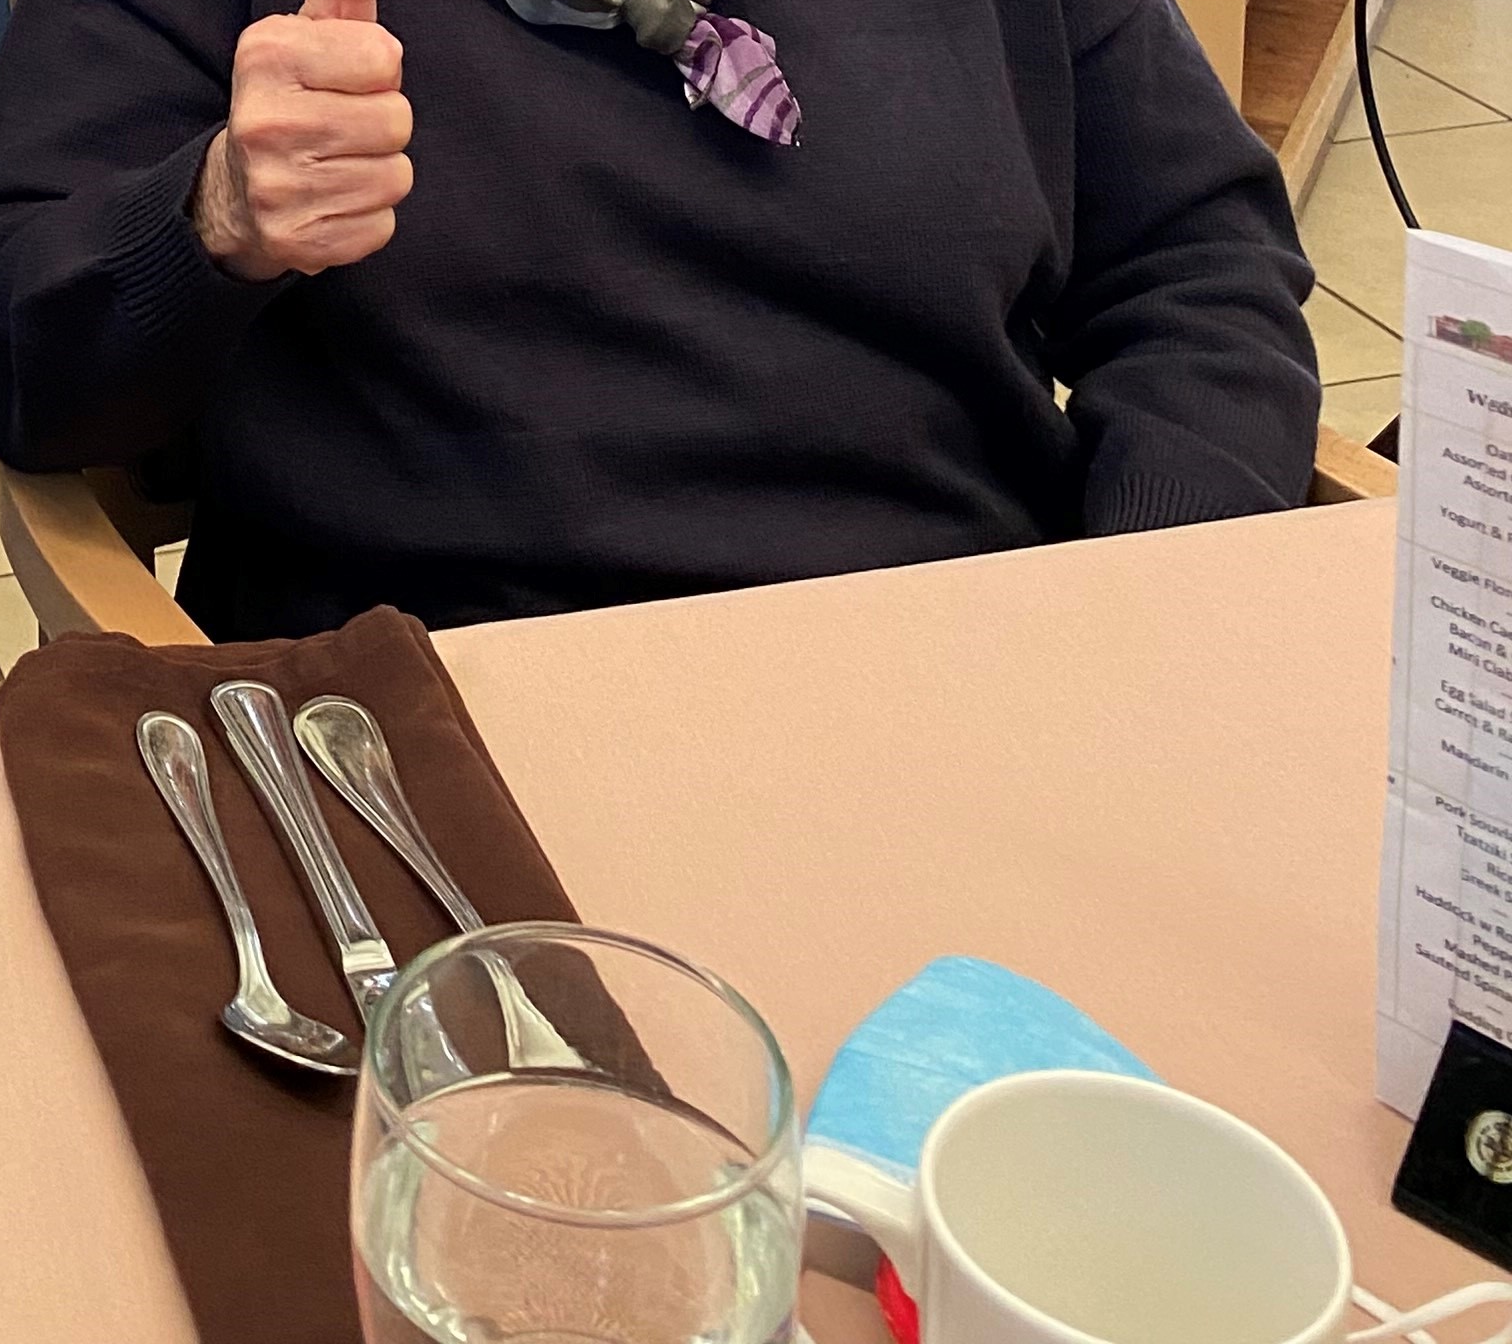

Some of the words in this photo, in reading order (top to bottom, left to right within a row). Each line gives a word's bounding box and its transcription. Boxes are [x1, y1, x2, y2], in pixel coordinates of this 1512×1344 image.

[1442, 447, 1506, 481] Assorted
[1491, 526, 1502, 540] &
[1430, 595, 1487, 627] Chicken
[1449, 622, 1492, 652] Bacon
[1496, 644, 1507, 659] &
[1440, 679, 1466, 703] Egg
[1441, 738, 1509, 781] Mandarin
[1435, 795, 1466, 818] Pork
[1416, 884, 1476, 926] Haddock
[1445, 938, 1500, 977] Mashed
